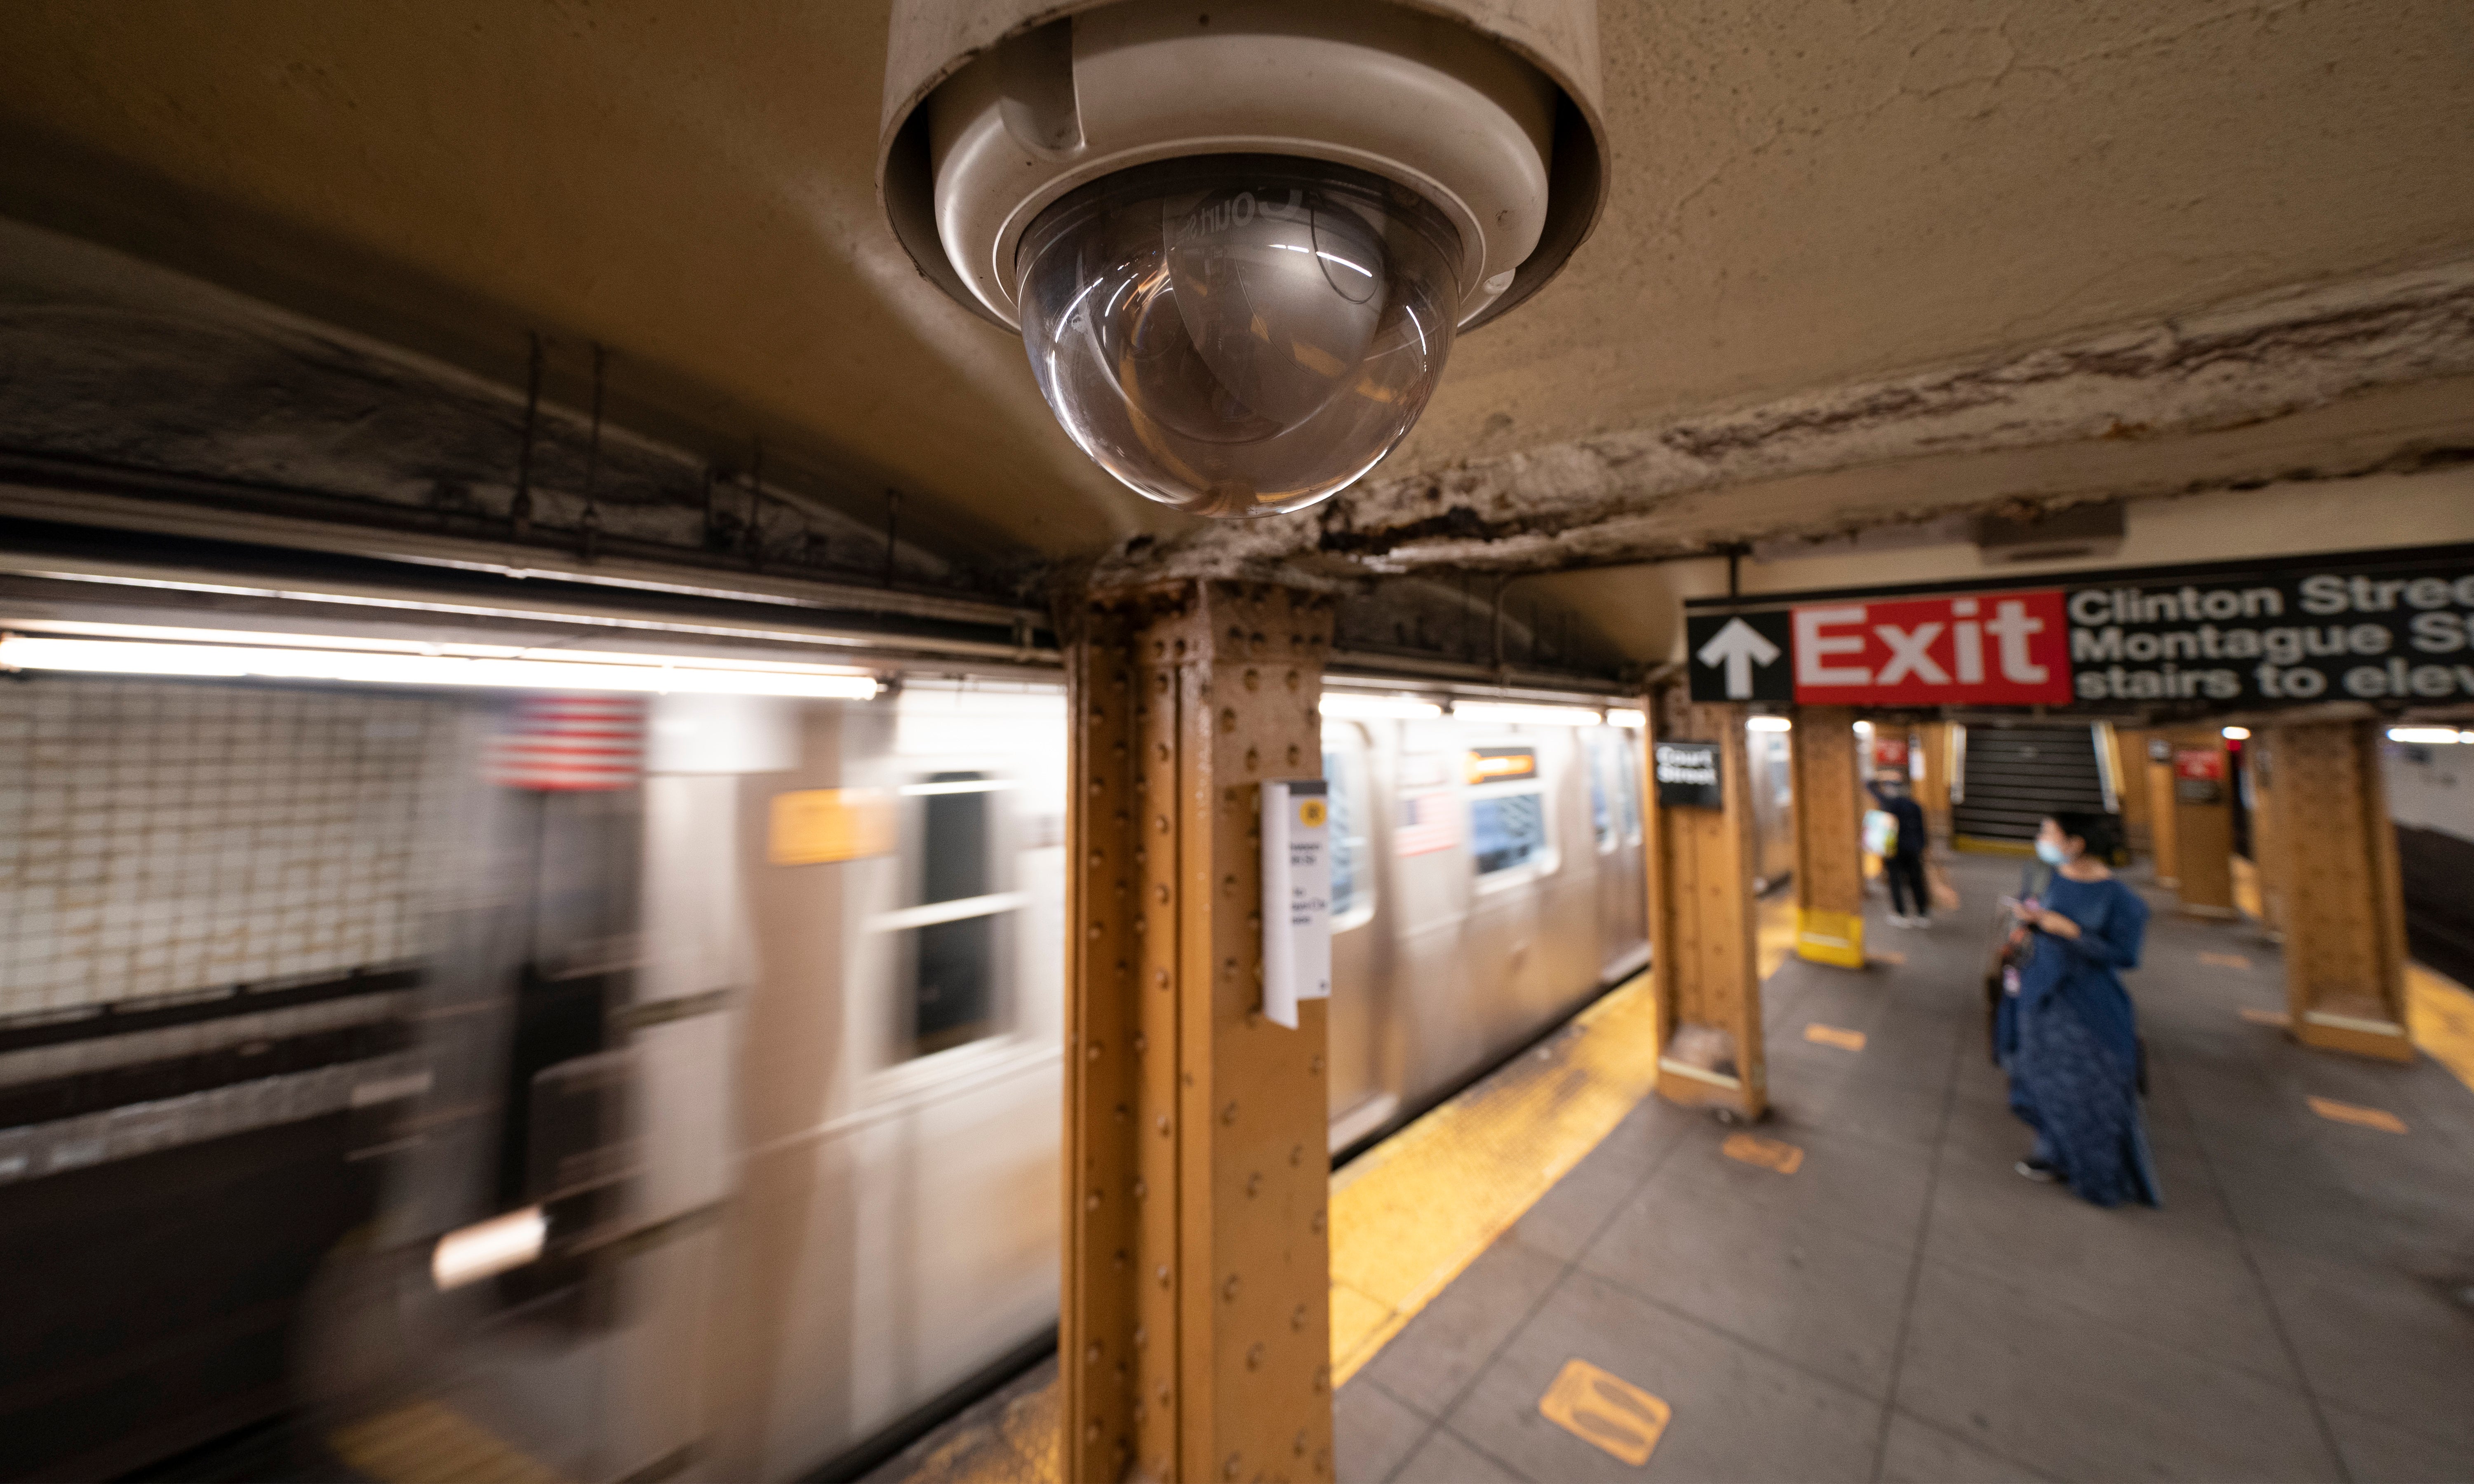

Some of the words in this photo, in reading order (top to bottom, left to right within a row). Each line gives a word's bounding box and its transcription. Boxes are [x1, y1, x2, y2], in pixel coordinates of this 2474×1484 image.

[2067, 586, 2285, 627] Clinton
[1794, 598, 2050, 686] Exit
[2070, 622, 2393, 667] Montague
[2408, 610, 2474, 654] S
[2074, 661, 2243, 699] stairs
[2252, 660, 2328, 698] to
